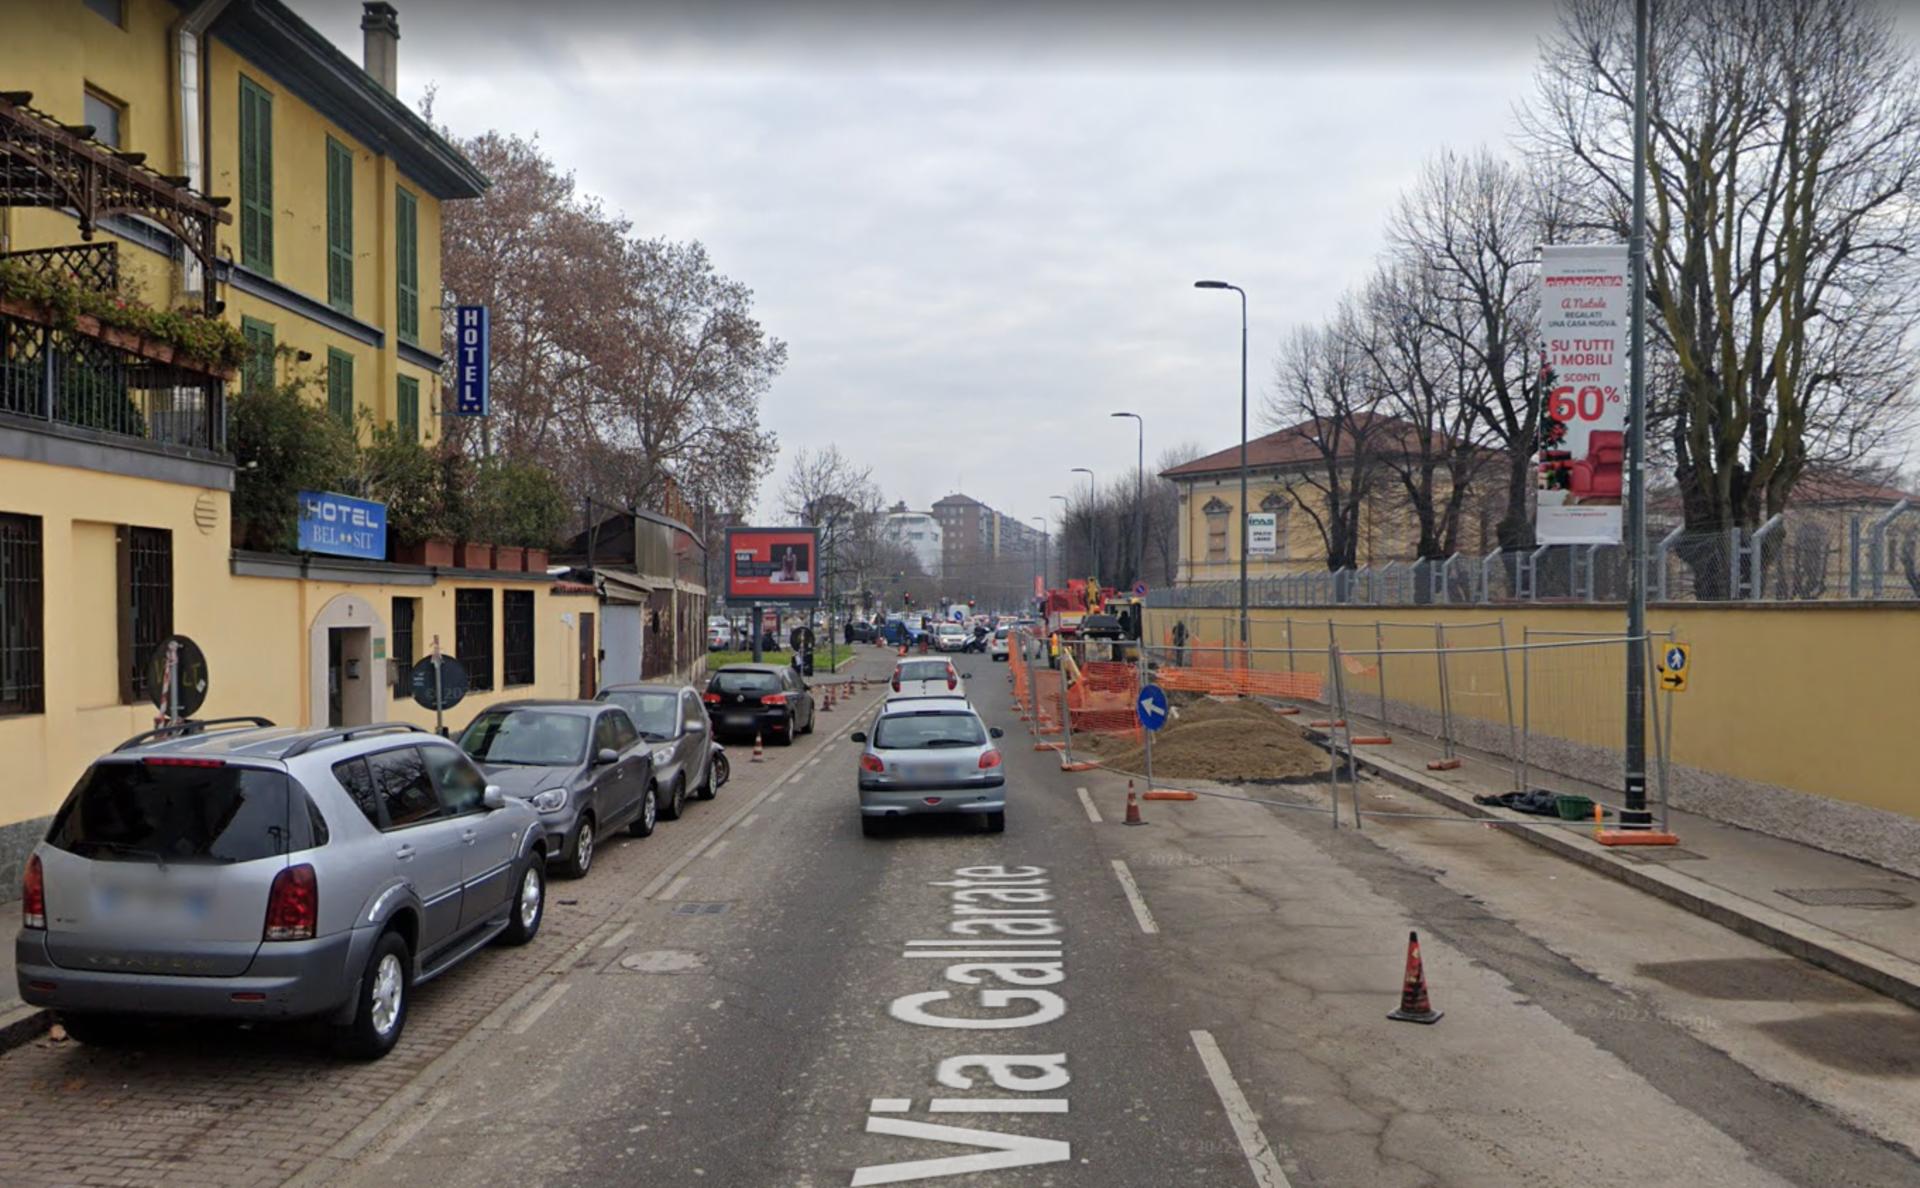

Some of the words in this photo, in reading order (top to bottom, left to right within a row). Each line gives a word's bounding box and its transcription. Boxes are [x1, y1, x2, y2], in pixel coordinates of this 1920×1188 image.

[1548, 320, 1565, 328] UNA
[1567, 320, 1587, 328] CASA
[464, 310, 478, 401] HOTEL
[1551, 339, 1569, 352] SU
[1573, 339, 1614, 352] TUTTI
[1552, 353, 1557, 366] I
[1561, 353, 1613, 366] MOBILI
[1563, 373, 1600, 382] SCONTI
[306, 498, 379, 529] HOTEL
[313, 525, 338, 546] BEL
[353, 531, 374, 550] SIT
[889, 865, 1067, 1029] Gallarate
[850, 1053, 1070, 1188] Via
